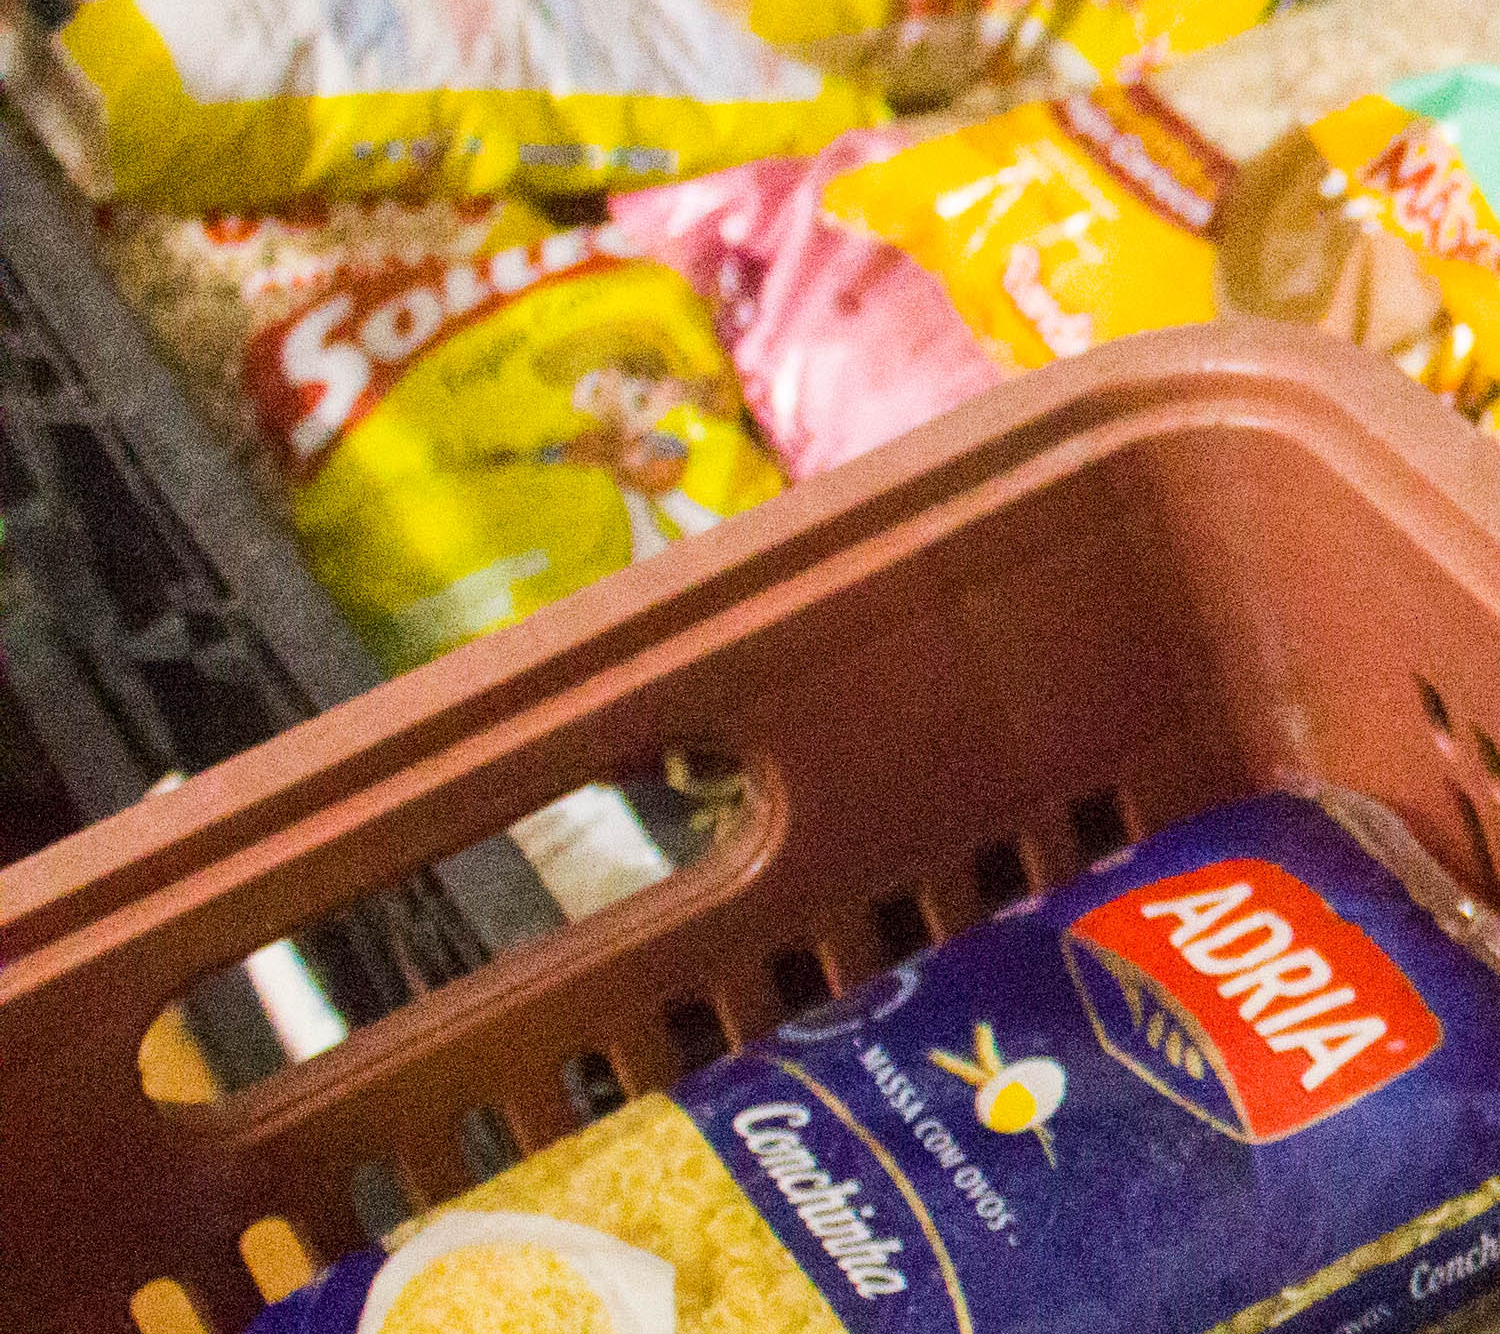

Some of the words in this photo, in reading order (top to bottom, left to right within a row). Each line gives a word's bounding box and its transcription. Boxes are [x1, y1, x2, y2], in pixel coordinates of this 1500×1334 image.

[1140, 881, 1390, 1094] ADRIA
[732, 1100, 911, 1304] Conchinha
[853, 1039, 926, 1129] MASSA
[908, 1110, 966, 1177] COM
[946, 1157, 1016, 1241] OVOS
